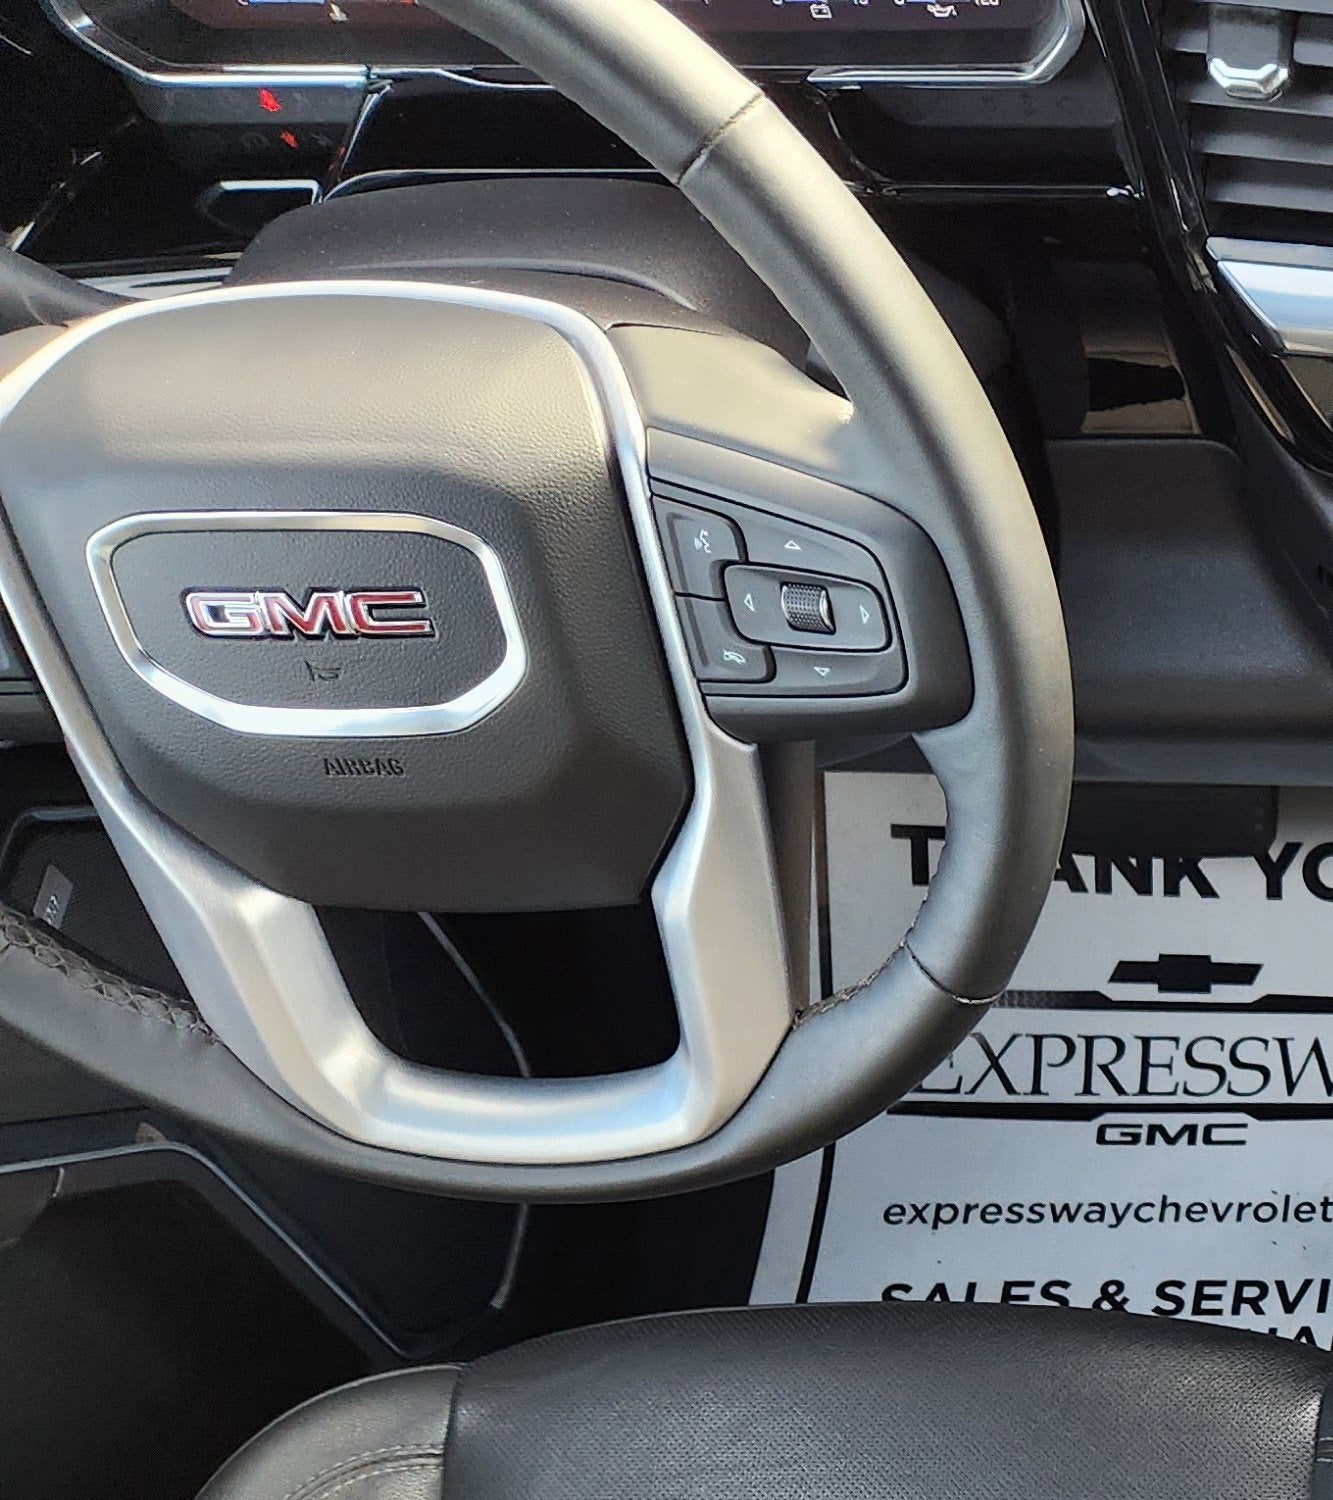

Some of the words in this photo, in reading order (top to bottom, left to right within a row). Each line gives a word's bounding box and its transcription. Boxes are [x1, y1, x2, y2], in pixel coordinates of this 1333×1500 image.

[183, 587, 435, 639] GMC
[323, 758, 404, 776] AIRBAG
[890, 823, 1220, 899] TNK
[1095, 1123, 1248, 1146] GMC
